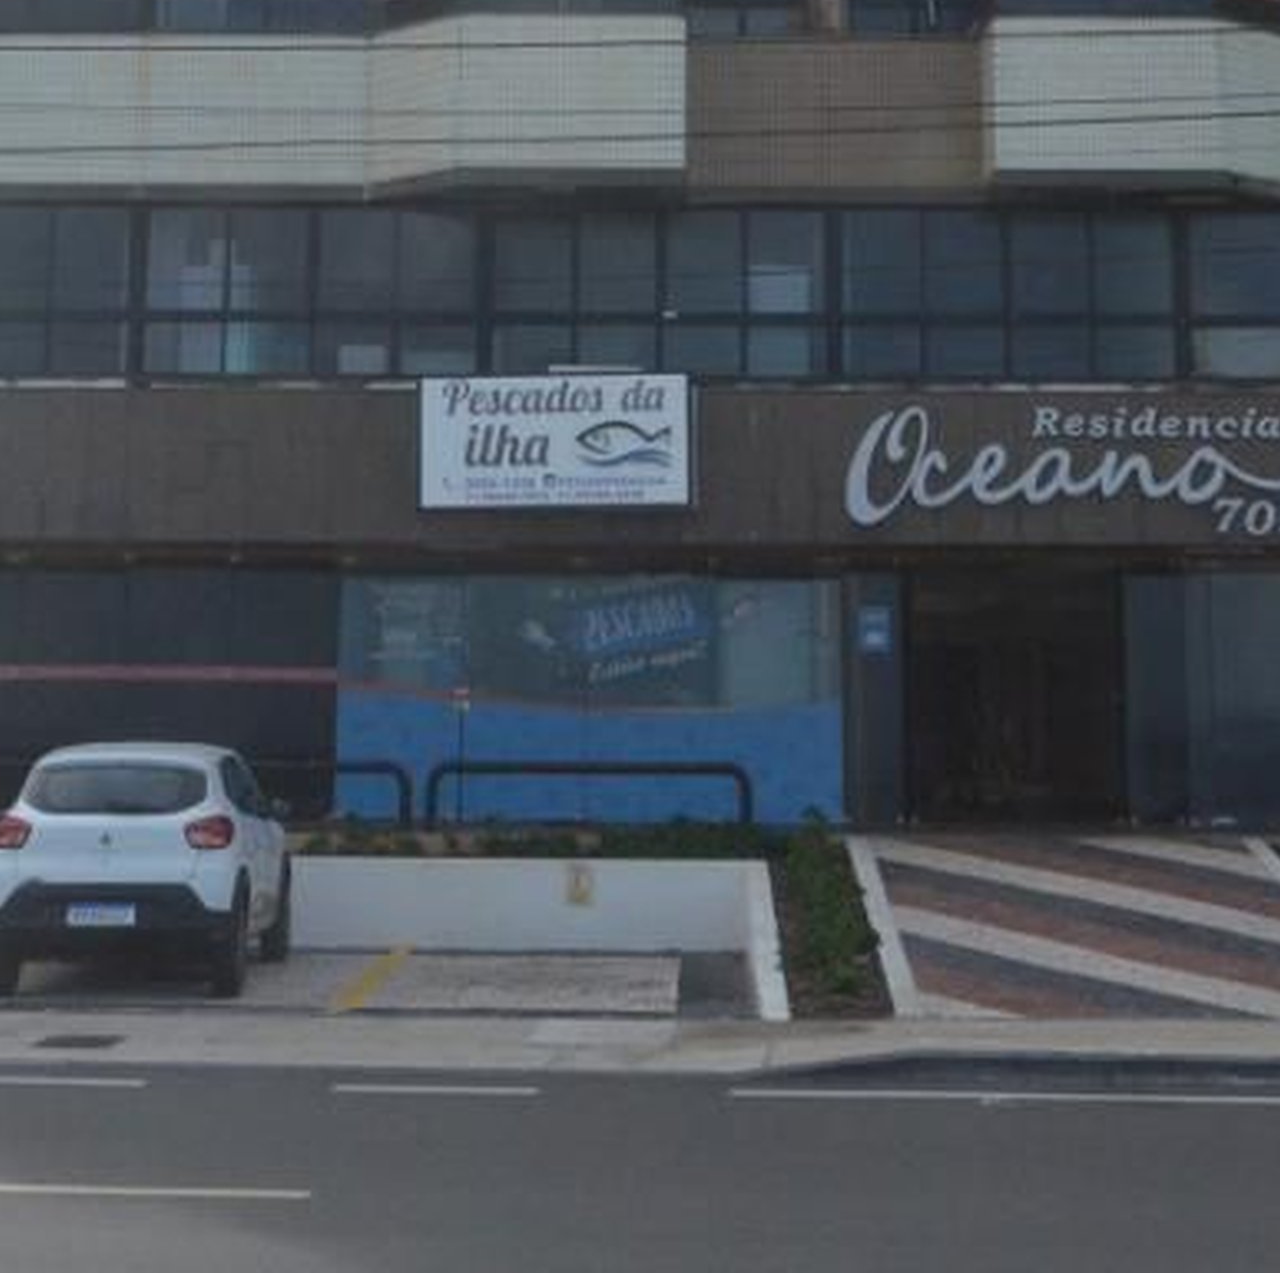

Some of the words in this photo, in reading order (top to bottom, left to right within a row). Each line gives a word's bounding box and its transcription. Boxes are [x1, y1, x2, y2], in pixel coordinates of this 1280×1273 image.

[441, 379, 604, 418] Pescados
[621, 379, 665, 413] da
[464, 423, 550, 468] ilha
